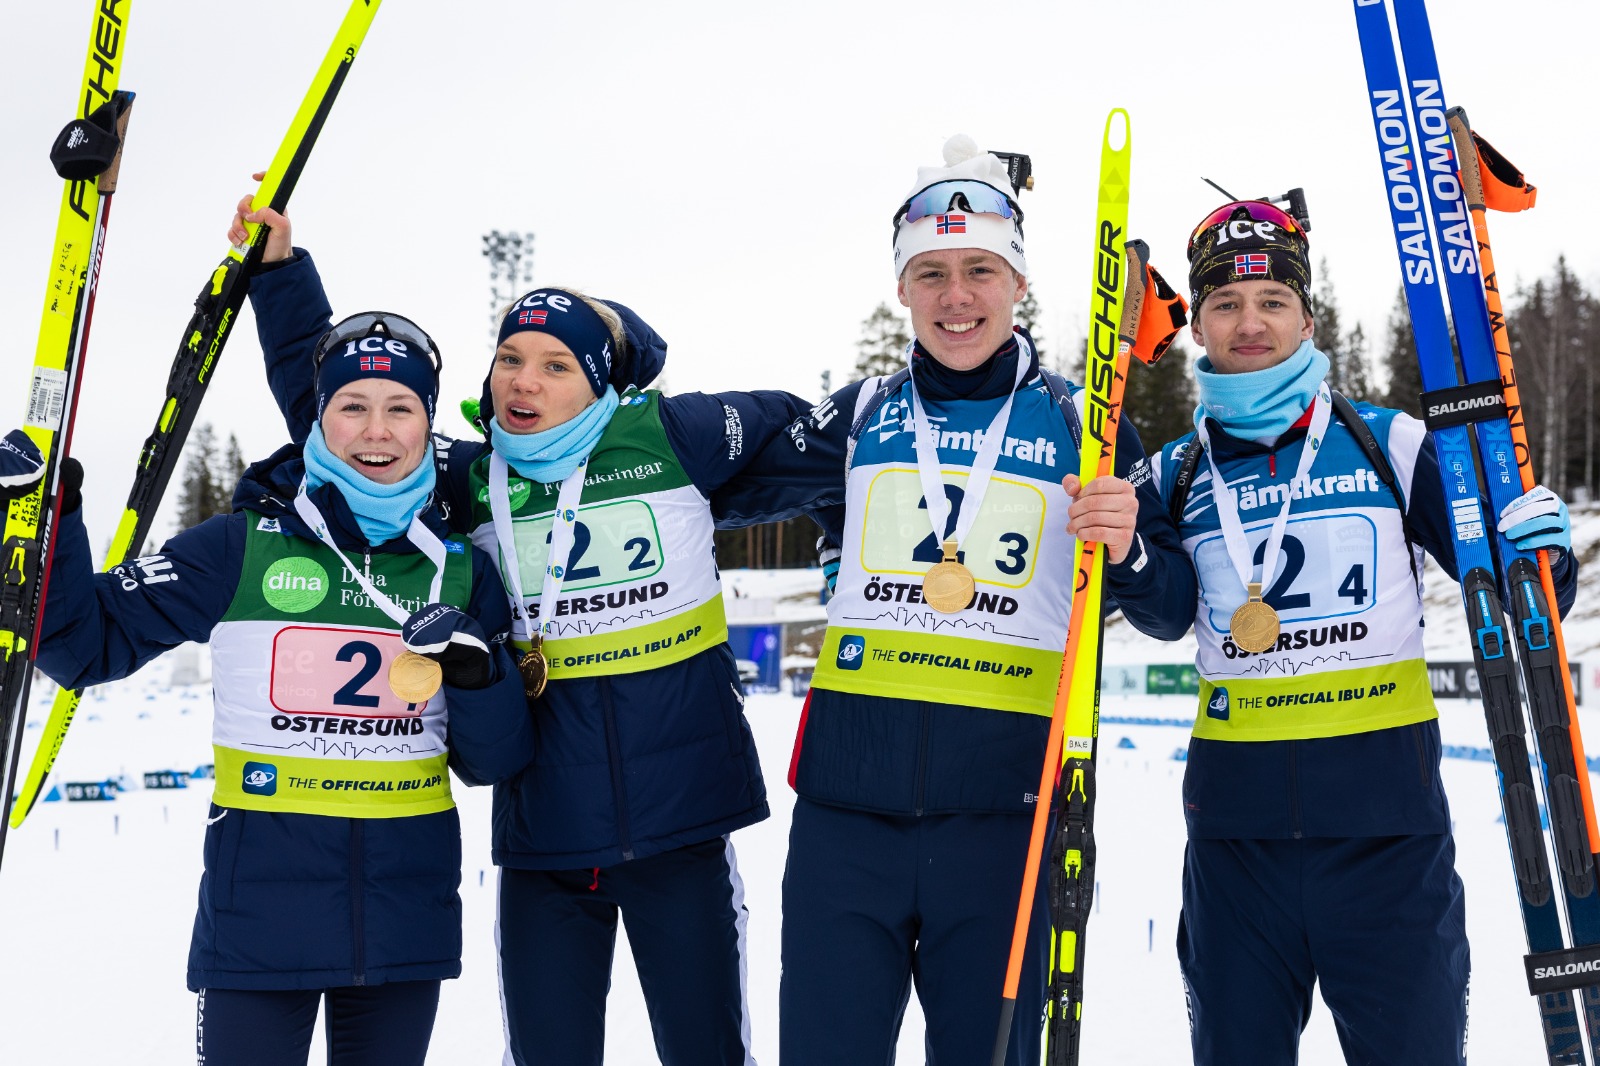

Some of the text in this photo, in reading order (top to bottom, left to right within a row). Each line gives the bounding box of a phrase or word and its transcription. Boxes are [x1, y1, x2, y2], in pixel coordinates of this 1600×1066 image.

[1372, 89, 1435, 285] SALOMON
[1412, 79, 1477, 275] SALOMON
[1214, 220, 1277, 245] ice
[510, 292, 572, 315] ice
[198, 307, 234, 385] FISCHER
[343, 336, 408, 359] ice
[1089, 219, 1122, 443] FISCHER
[1428, 393, 1507, 418] SALOMON
[912, 484, 1029, 575] 2 3
[545, 520, 601, 582] 2
[624, 537, 656, 572] 2
[268, 572, 322, 592] dina
[1253, 534, 1368, 611] 2 4
[411, 608, 441, 631] CRAFT
[564, 647, 641, 667] OFFICIAL
[645, 637, 672, 654] IBU
[675, 625, 702, 645] APP
[871, 649, 1033, 678] THE OFFICIAL IBU APP
[333, 640, 383, 708] 2
[1237, 682, 1397, 709] THE OFFICIAL IBU APP
[288, 775, 443, 792] THE OFFICIAL IBU APP
